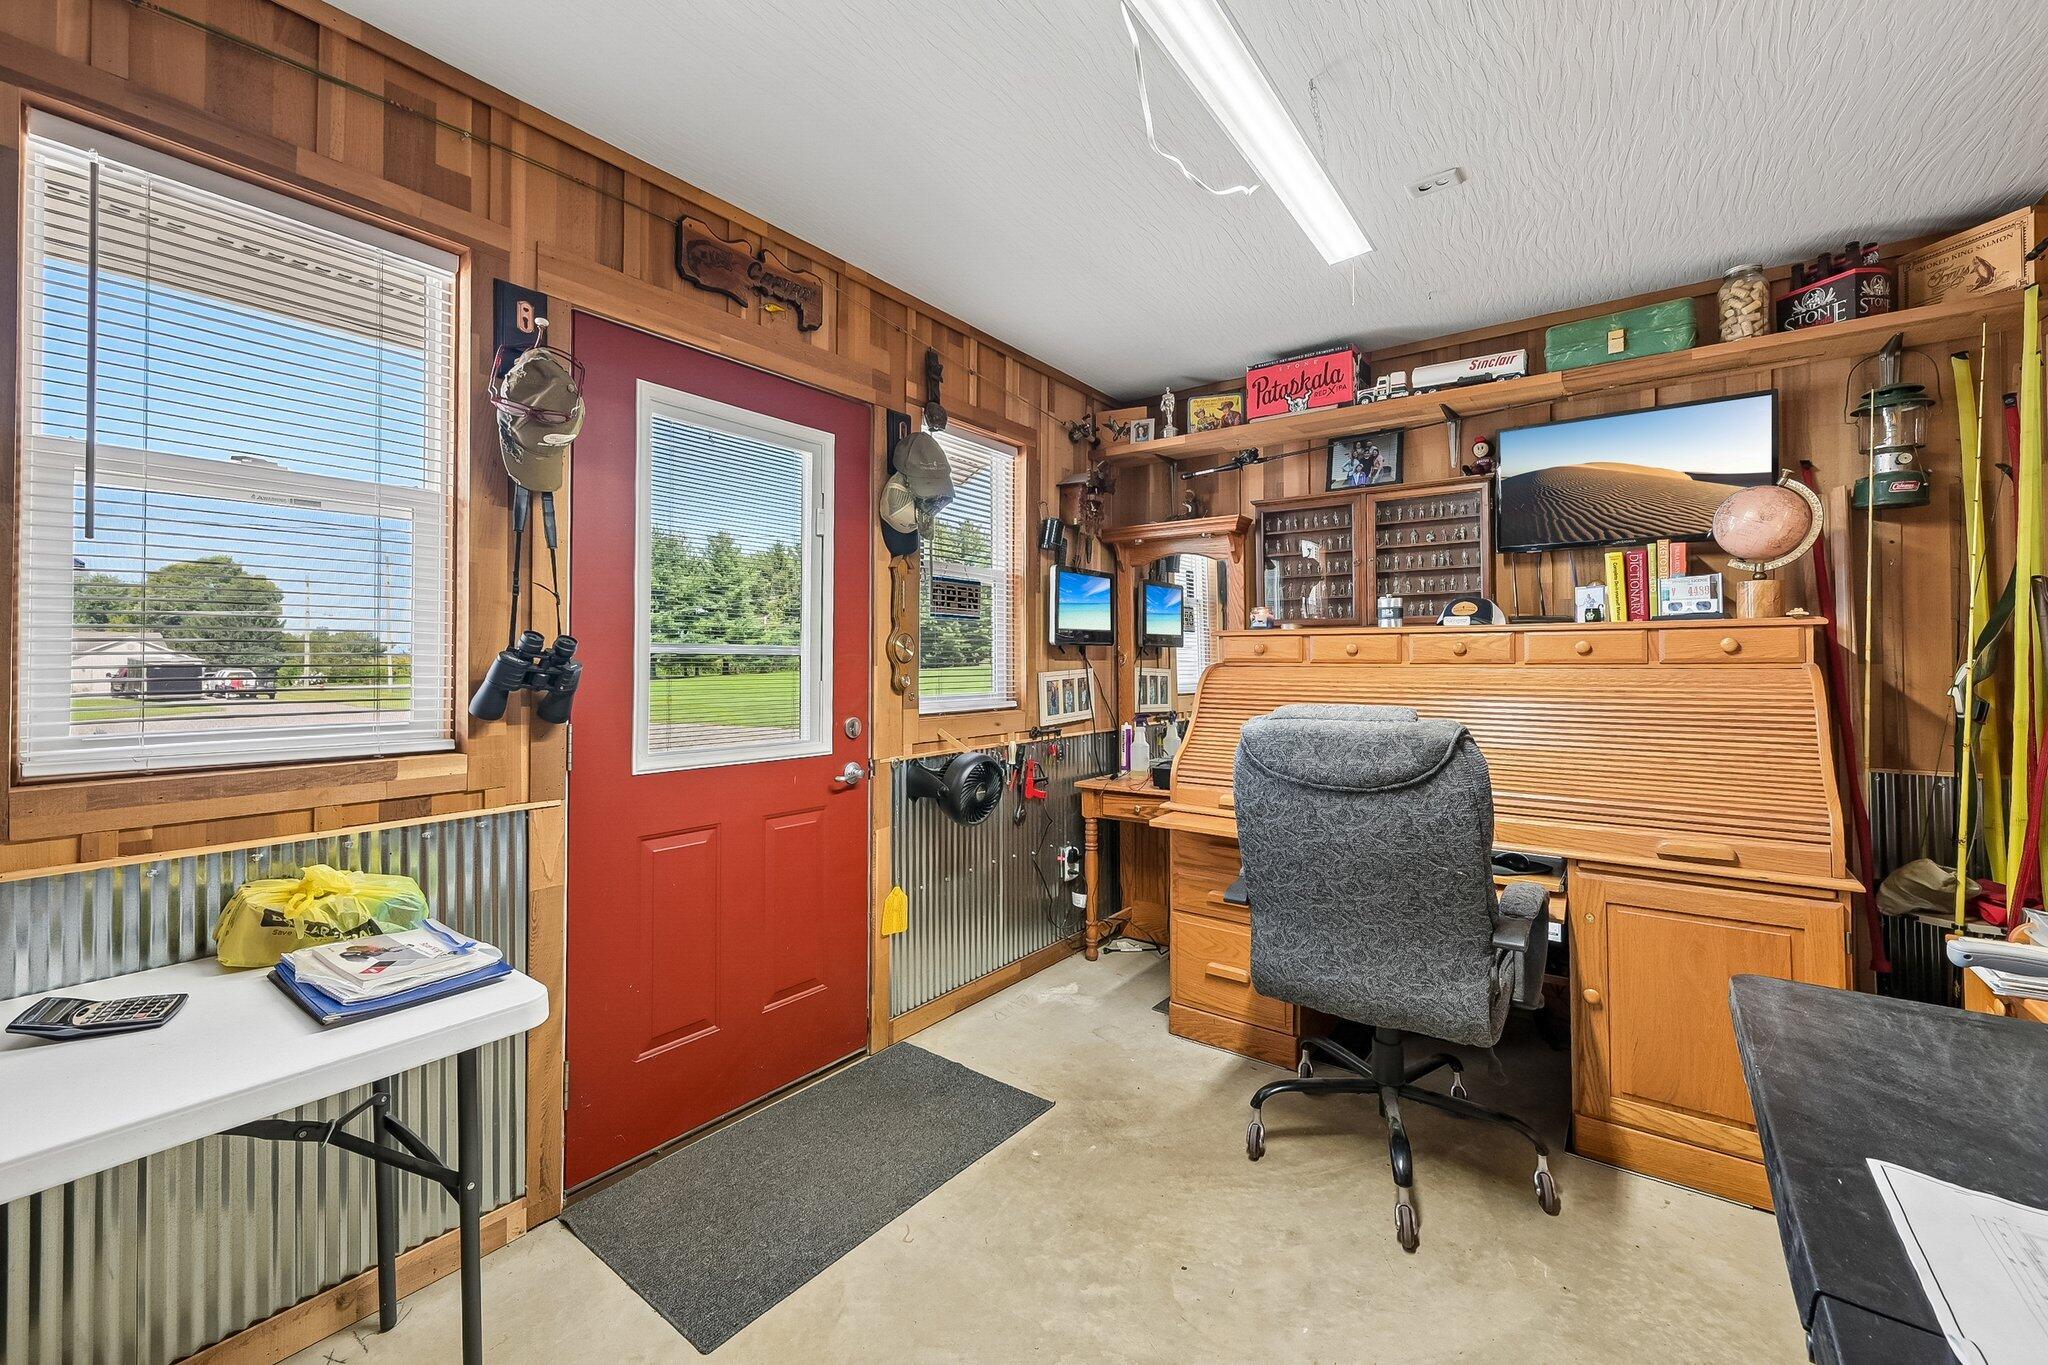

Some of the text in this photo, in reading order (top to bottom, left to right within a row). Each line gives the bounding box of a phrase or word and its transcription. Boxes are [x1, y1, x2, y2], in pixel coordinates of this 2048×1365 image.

[1915, 233, 2014, 273] SMOKED KING SALMON
[1784, 299, 1847, 331] STONE
[1469, 354, 1518, 370] Sinclair
[1252, 361, 1344, 409] Pataskala
[1314, 389, 1327, 398] RED
[1326, 384, 1336, 397] X
[1629, 554, 1641, 615] DICTIONARY
